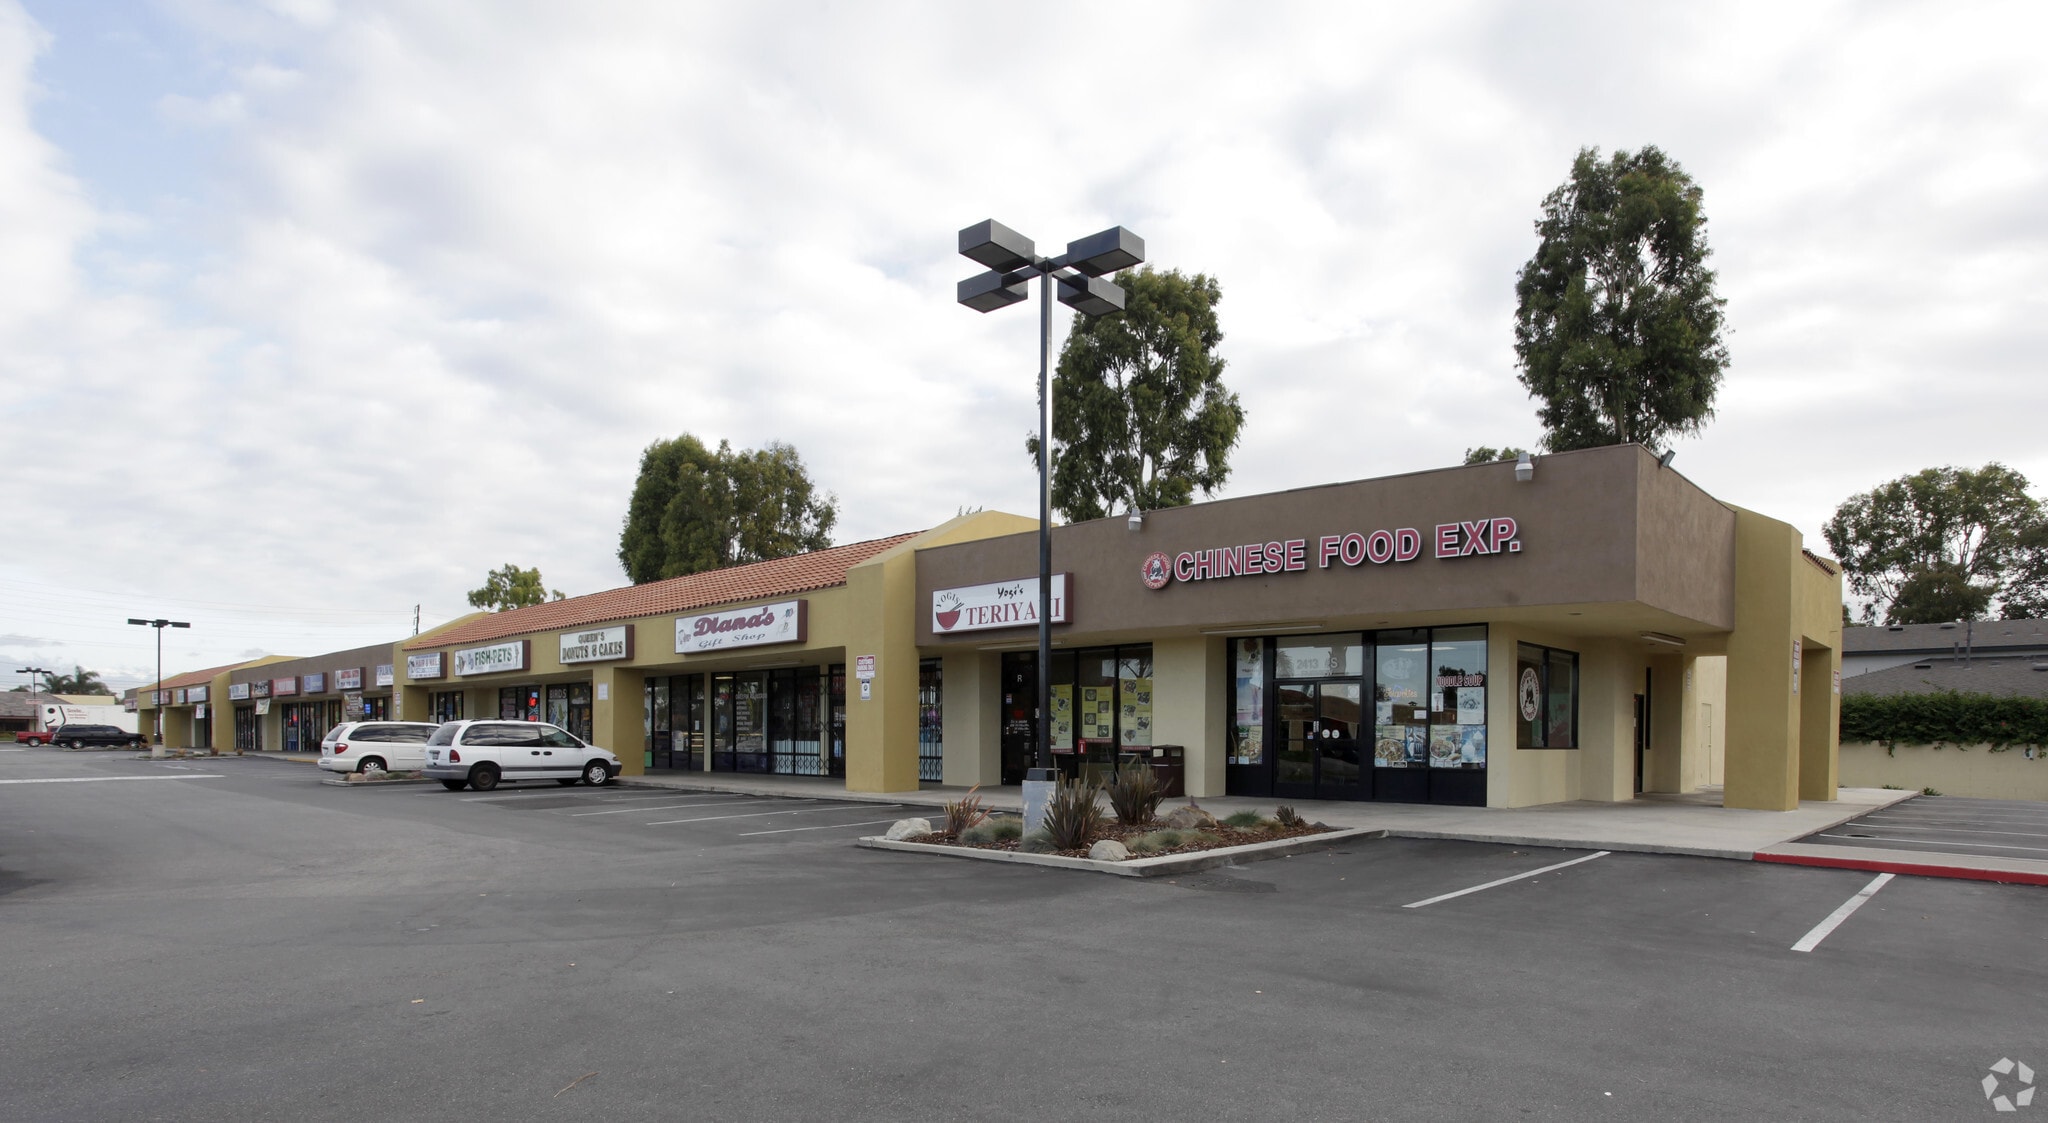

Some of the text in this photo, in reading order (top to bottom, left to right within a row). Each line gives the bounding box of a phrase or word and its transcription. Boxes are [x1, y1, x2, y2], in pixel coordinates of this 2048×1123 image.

[1174, 517, 1521, 582] CHINESE FOOD EXP.
[997, 584, 1024, 599] Yogi's
[966, 597, 1061, 626] TERIYAI
[693, 606, 775, 637] Diana's
[699, 633, 766, 649] Gift Shop
[562, 645, 589, 660] DONUTS
[599, 641, 624, 656] CAKES
[1297, 658, 1318, 670] 2413
[1436, 675, 1484, 687] NOODLE SOUP
[549, 688, 567, 699] BIRDS
